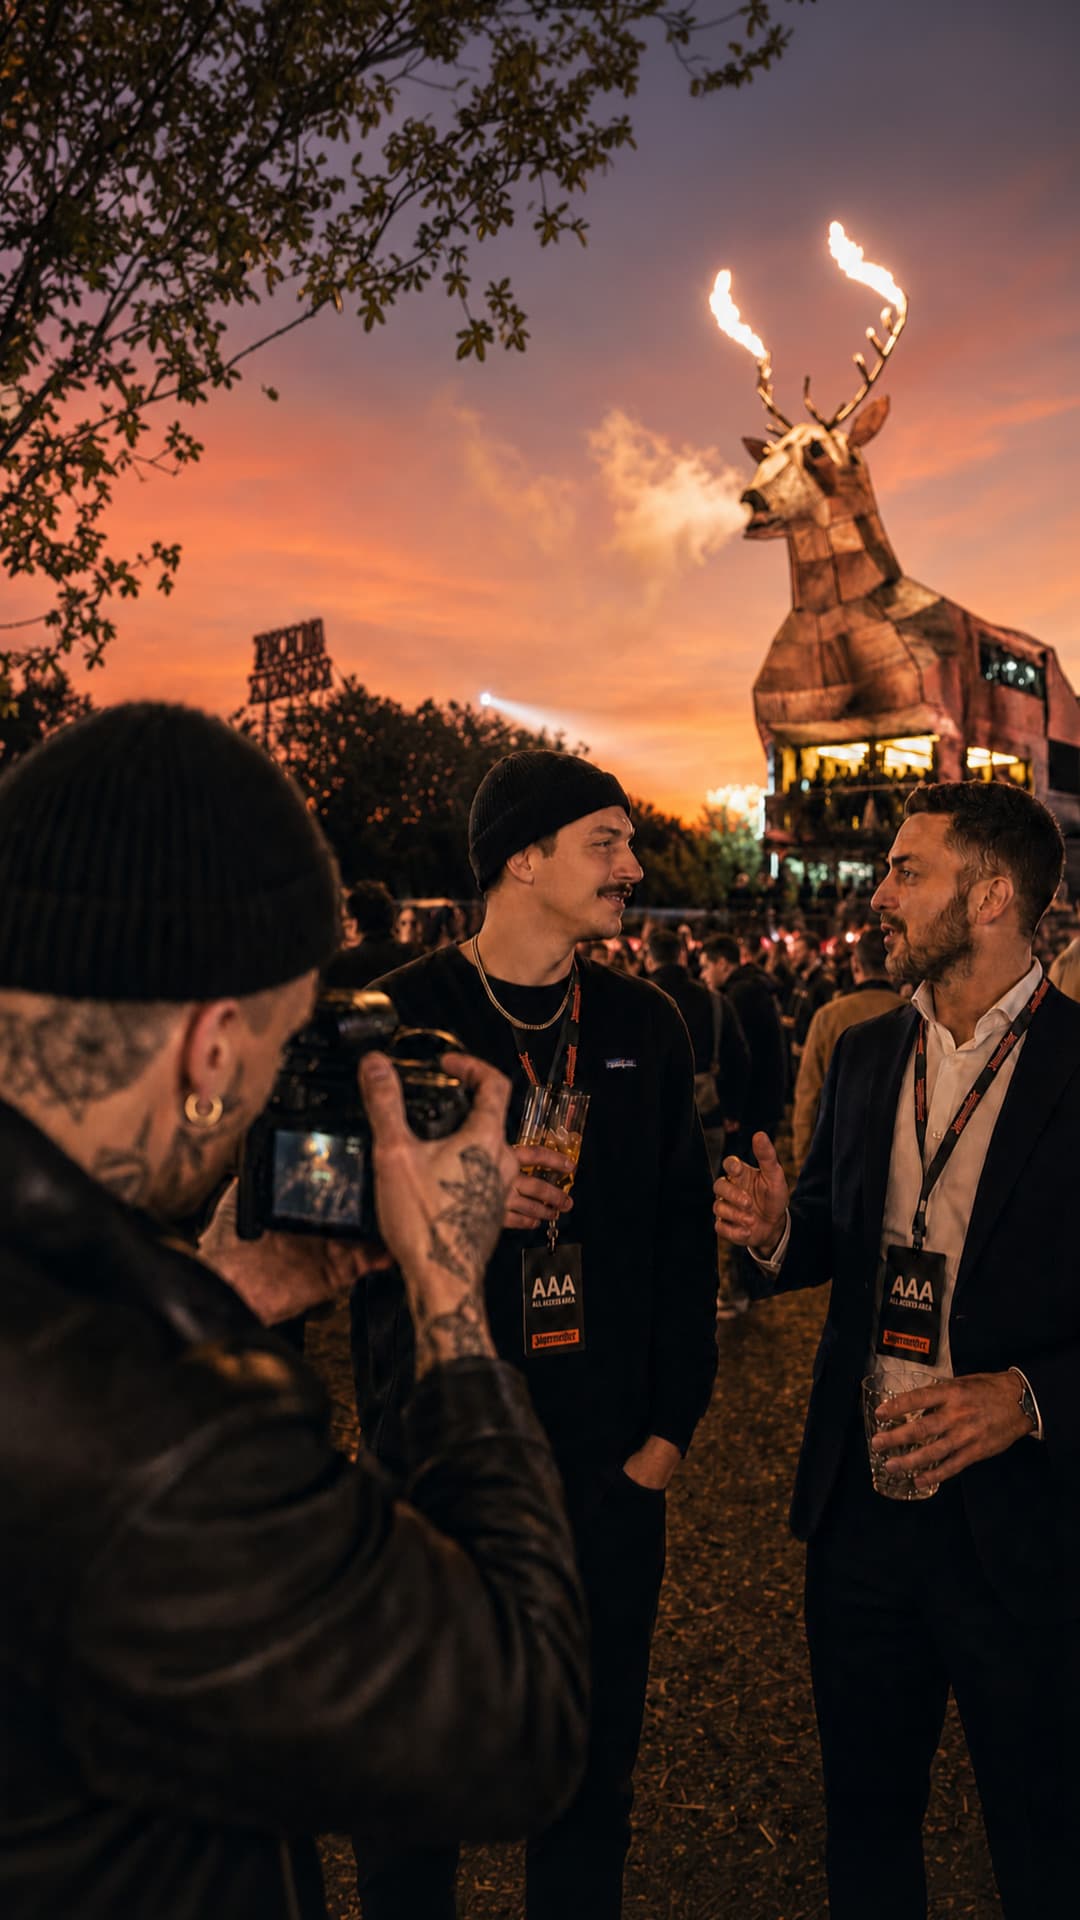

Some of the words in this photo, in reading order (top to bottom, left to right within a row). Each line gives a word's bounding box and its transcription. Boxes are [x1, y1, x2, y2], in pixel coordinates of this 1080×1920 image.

[532, 1274, 576, 1299] AAA
[891, 1275, 934, 1303] AAA
[532, 1299, 542, 1308] ALL
[543, 1298, 561, 1306] ACCESS
[562, 1296, 576, 1305] AREA
[890, 1297, 898, 1306] ALL
[899, 1299, 917, 1310] ACCESS
[918, 1302, 932, 1312] AREA
